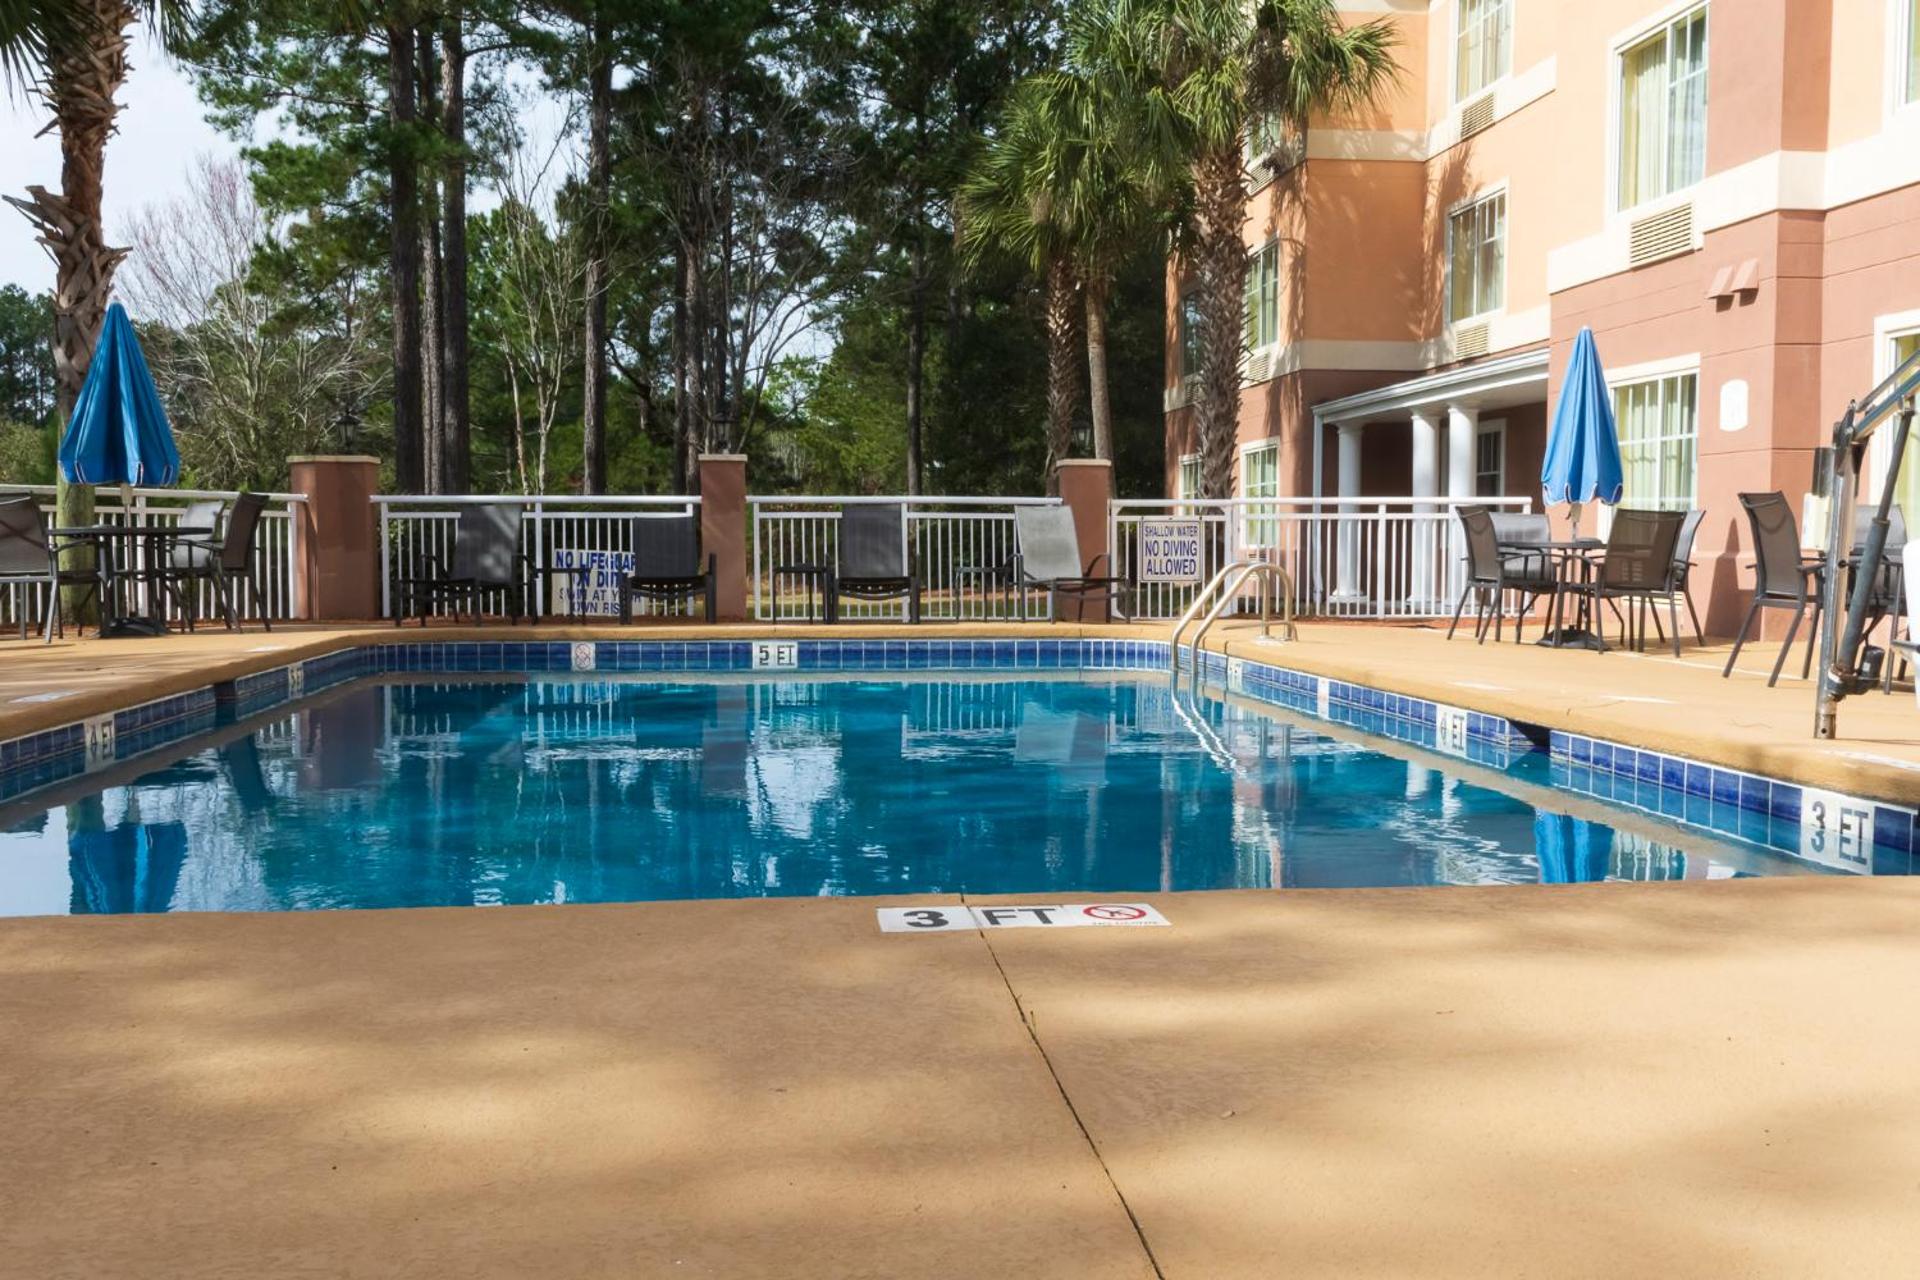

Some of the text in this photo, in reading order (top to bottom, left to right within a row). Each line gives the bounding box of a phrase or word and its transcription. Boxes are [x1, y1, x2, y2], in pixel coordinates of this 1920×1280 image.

[1145, 525, 1198, 537] SHALLOW WATER
[1145, 540, 1198, 556] NO DIVING
[556, 551, 636, 571] NO LIFEGUAR
[1146, 559, 1196, 575] ALLOWED
[597, 571, 620, 588] DUT
[592, 589, 606, 601] AT
[602, 602, 621, 614] RIS
[903, 908, 1056, 928] 3 FT
